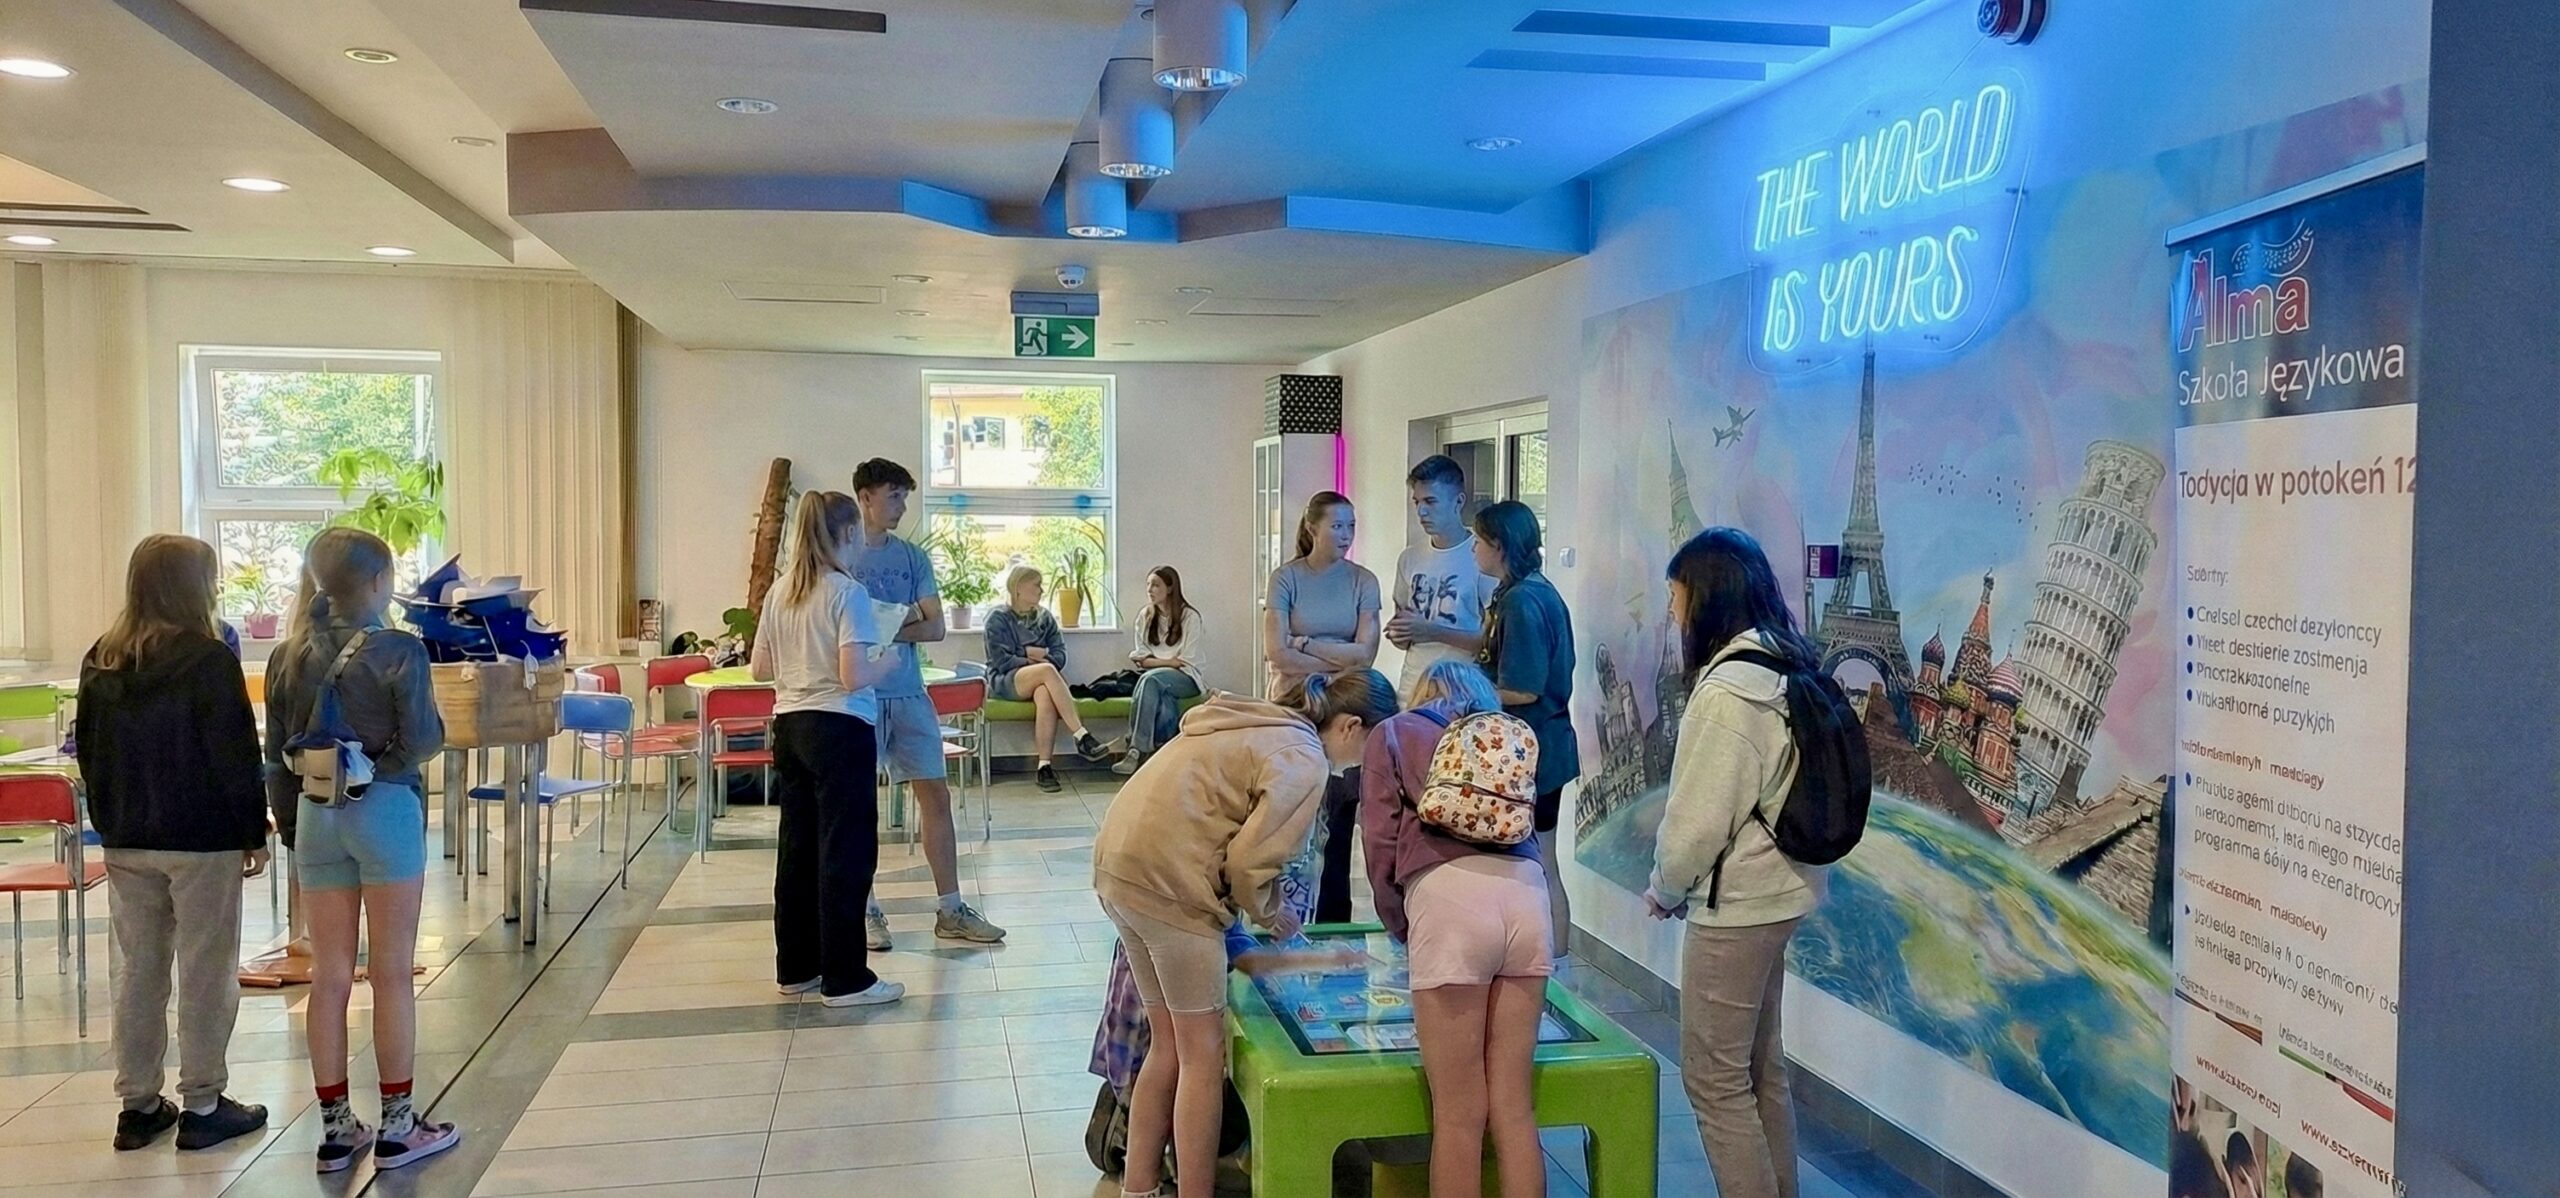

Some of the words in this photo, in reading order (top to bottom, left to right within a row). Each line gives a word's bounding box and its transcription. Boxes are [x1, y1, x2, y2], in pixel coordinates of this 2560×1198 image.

[1754, 151, 1832, 252] THE
[1840, 84, 2013, 222] WORLD
[1763, 270, 1807, 352] IS
[1819, 225, 1978, 343] YOURS
[2176, 248, 2310, 353] Alma
[2178, 360, 2249, 406] Szkoła
[2259, 344, 2405, 402] Językowa
[2254, 472, 2275, 497] w
